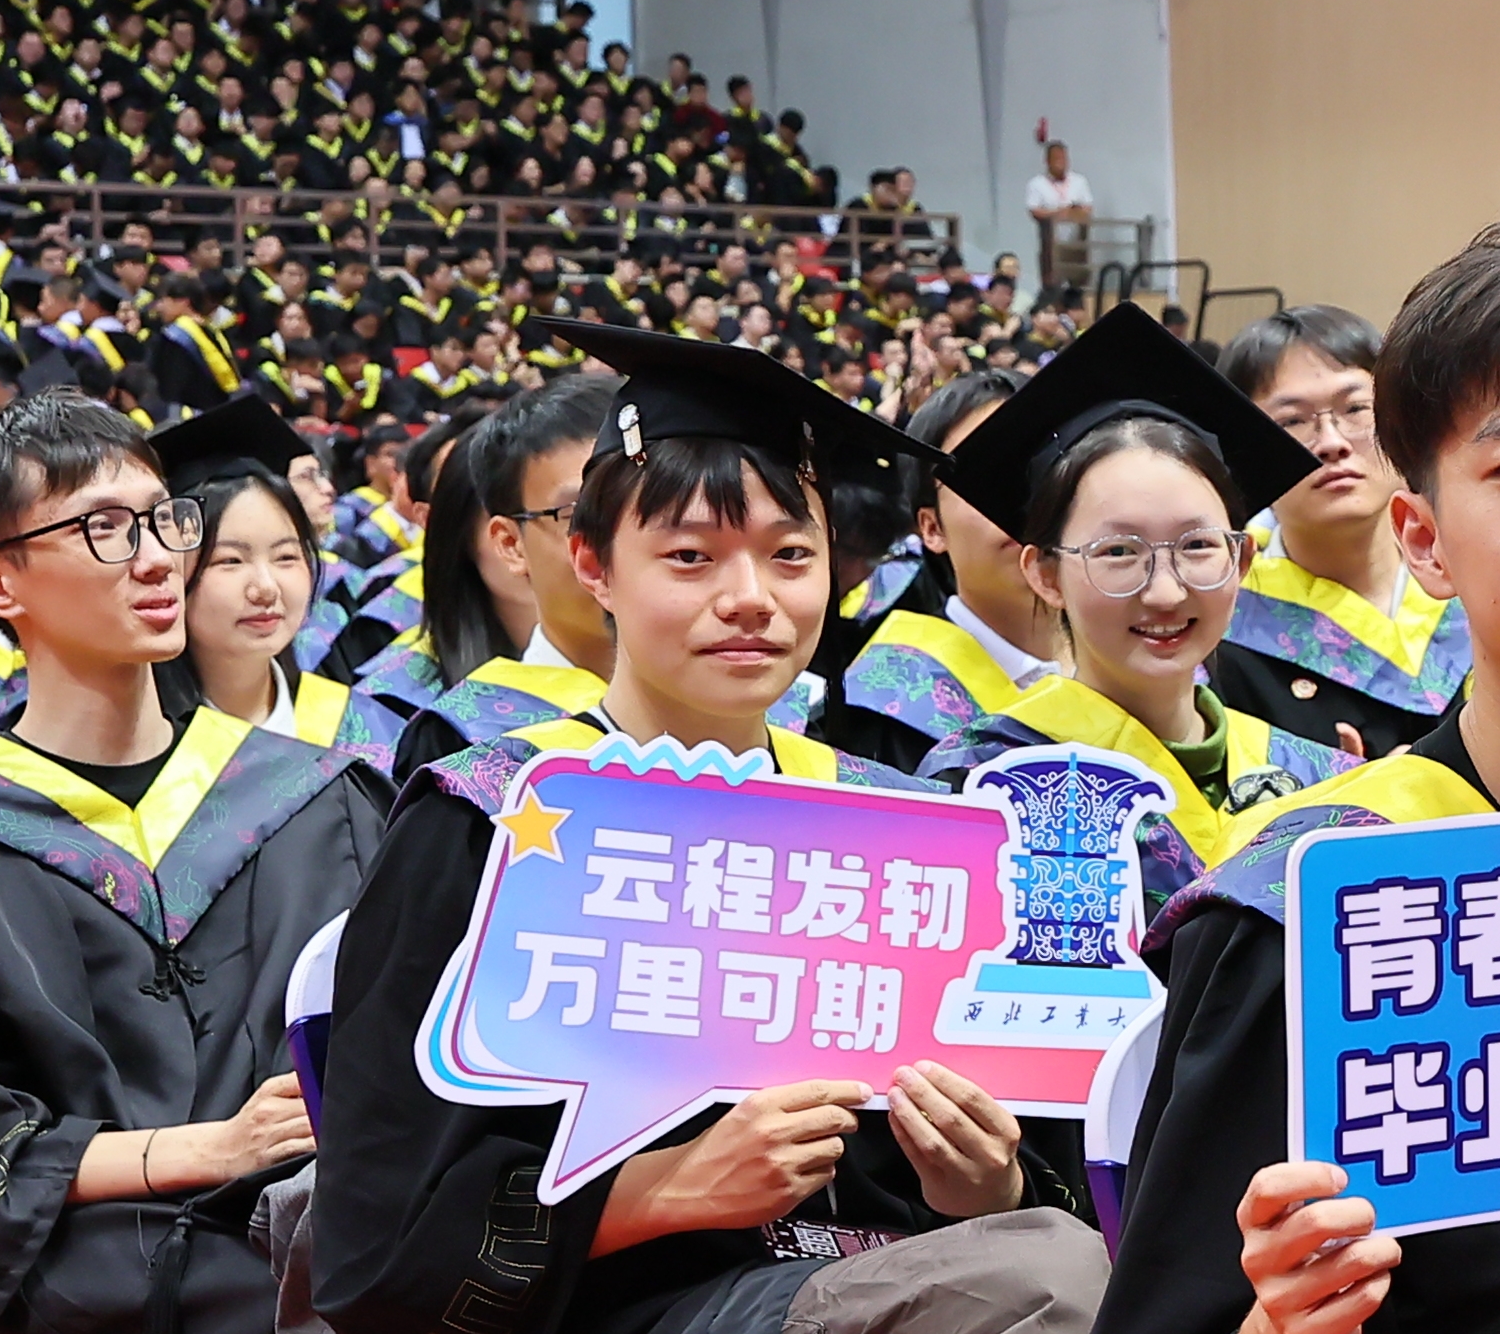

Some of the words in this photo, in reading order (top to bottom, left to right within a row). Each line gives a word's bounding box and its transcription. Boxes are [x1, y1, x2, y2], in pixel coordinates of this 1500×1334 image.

[582, 825, 971, 953] 云程发轫
[507, 931, 904, 1055] 万里可期
